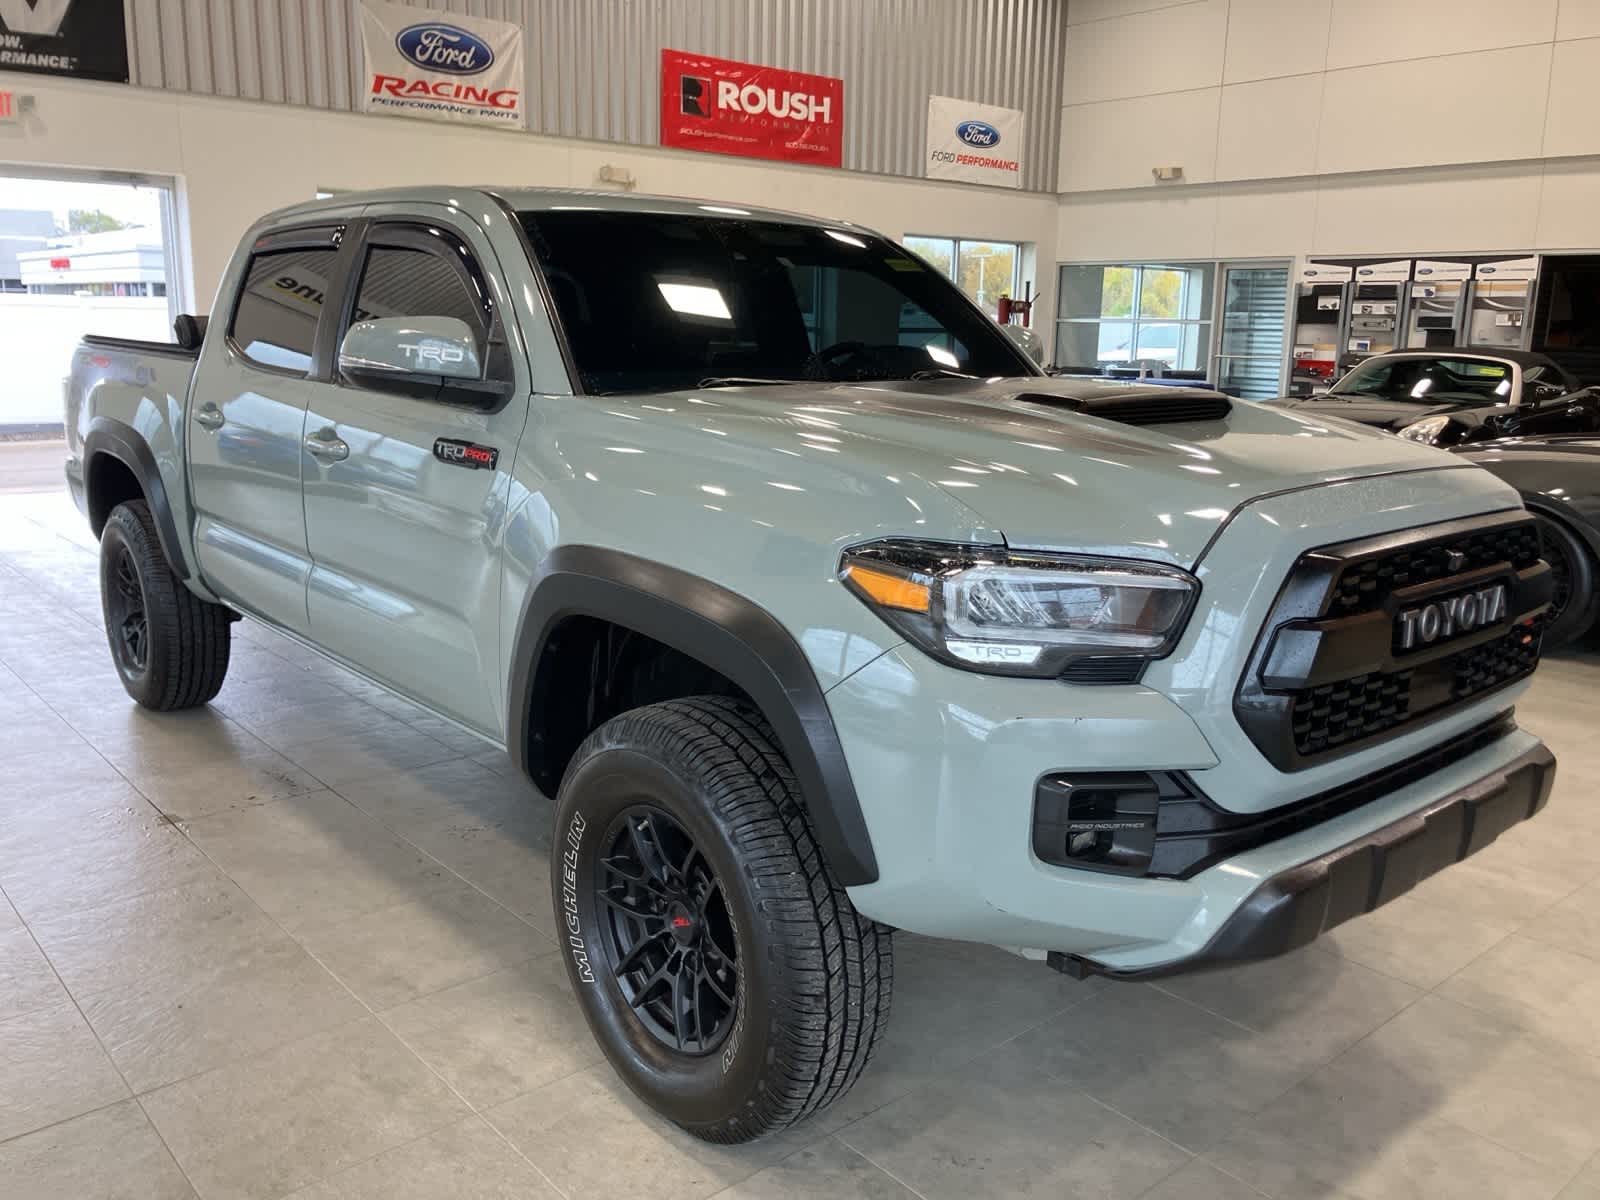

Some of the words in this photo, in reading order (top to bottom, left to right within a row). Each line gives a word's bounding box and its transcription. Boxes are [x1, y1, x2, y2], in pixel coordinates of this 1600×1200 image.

[415, 30, 475, 68] Ford
[371, 73, 520, 109] RACING
[717, 80, 831, 123] ROUSH
[372, 97, 477, 116] PERFORMANCE
[480, 109, 519, 120] PARTS
[964, 124, 992, 144] Ford
[931, 151, 955, 163] FORD
[956, 154, 1020, 172] PERFORMANCE
[397, 343, 464, 364] TRD
[1402, 584, 1506, 649] TOYOTA
[968, 645, 1022, 659] TRD
[563, 810, 594, 983] MICHELIN
